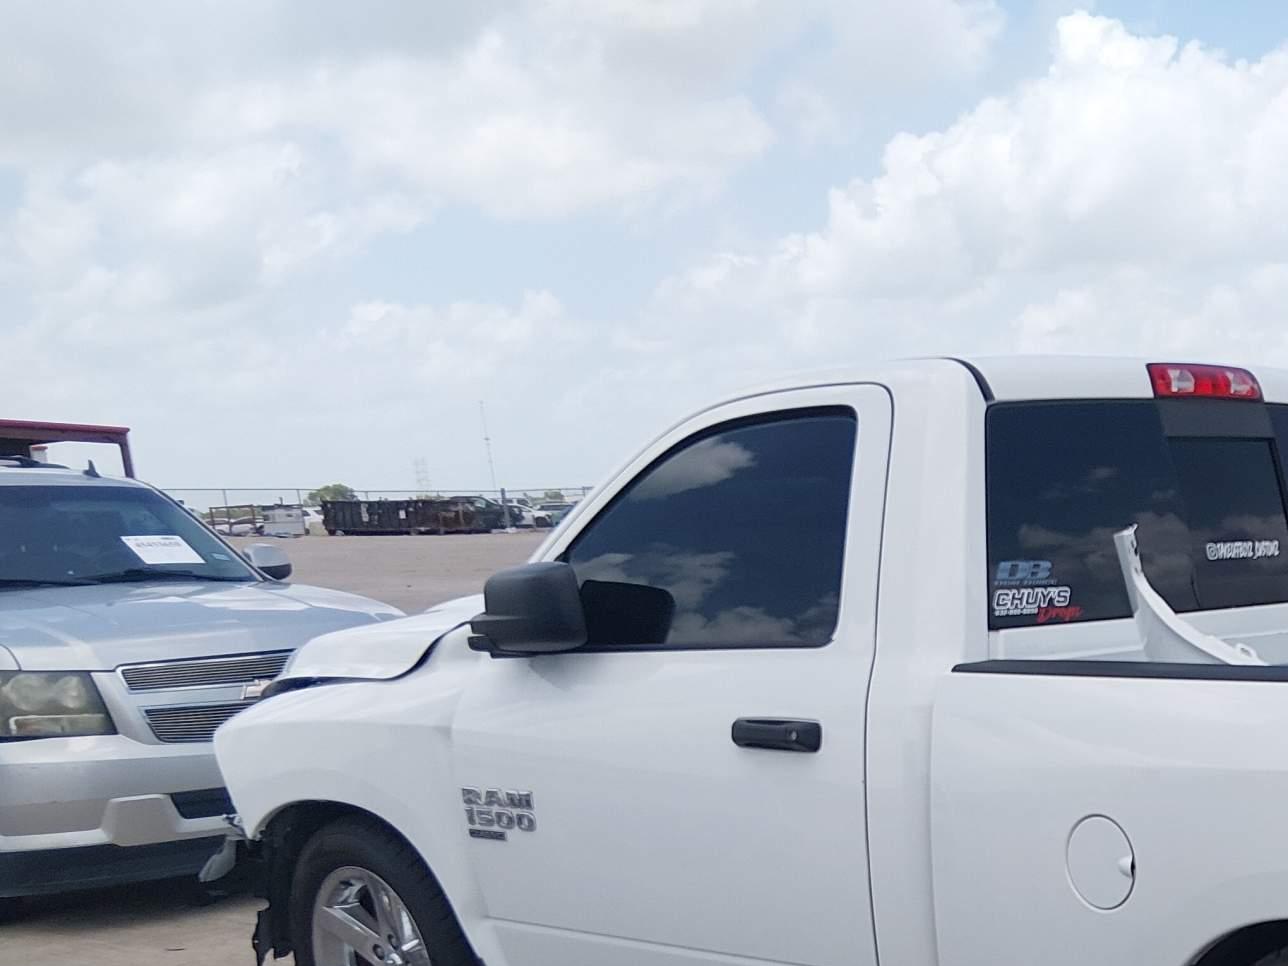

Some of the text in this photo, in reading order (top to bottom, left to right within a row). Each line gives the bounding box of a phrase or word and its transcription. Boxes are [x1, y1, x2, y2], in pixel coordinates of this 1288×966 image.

[993, 586, 1071, 610] CHUY'S
[462, 787, 533, 809] RAM
[465, 807, 537, 832] 1500
